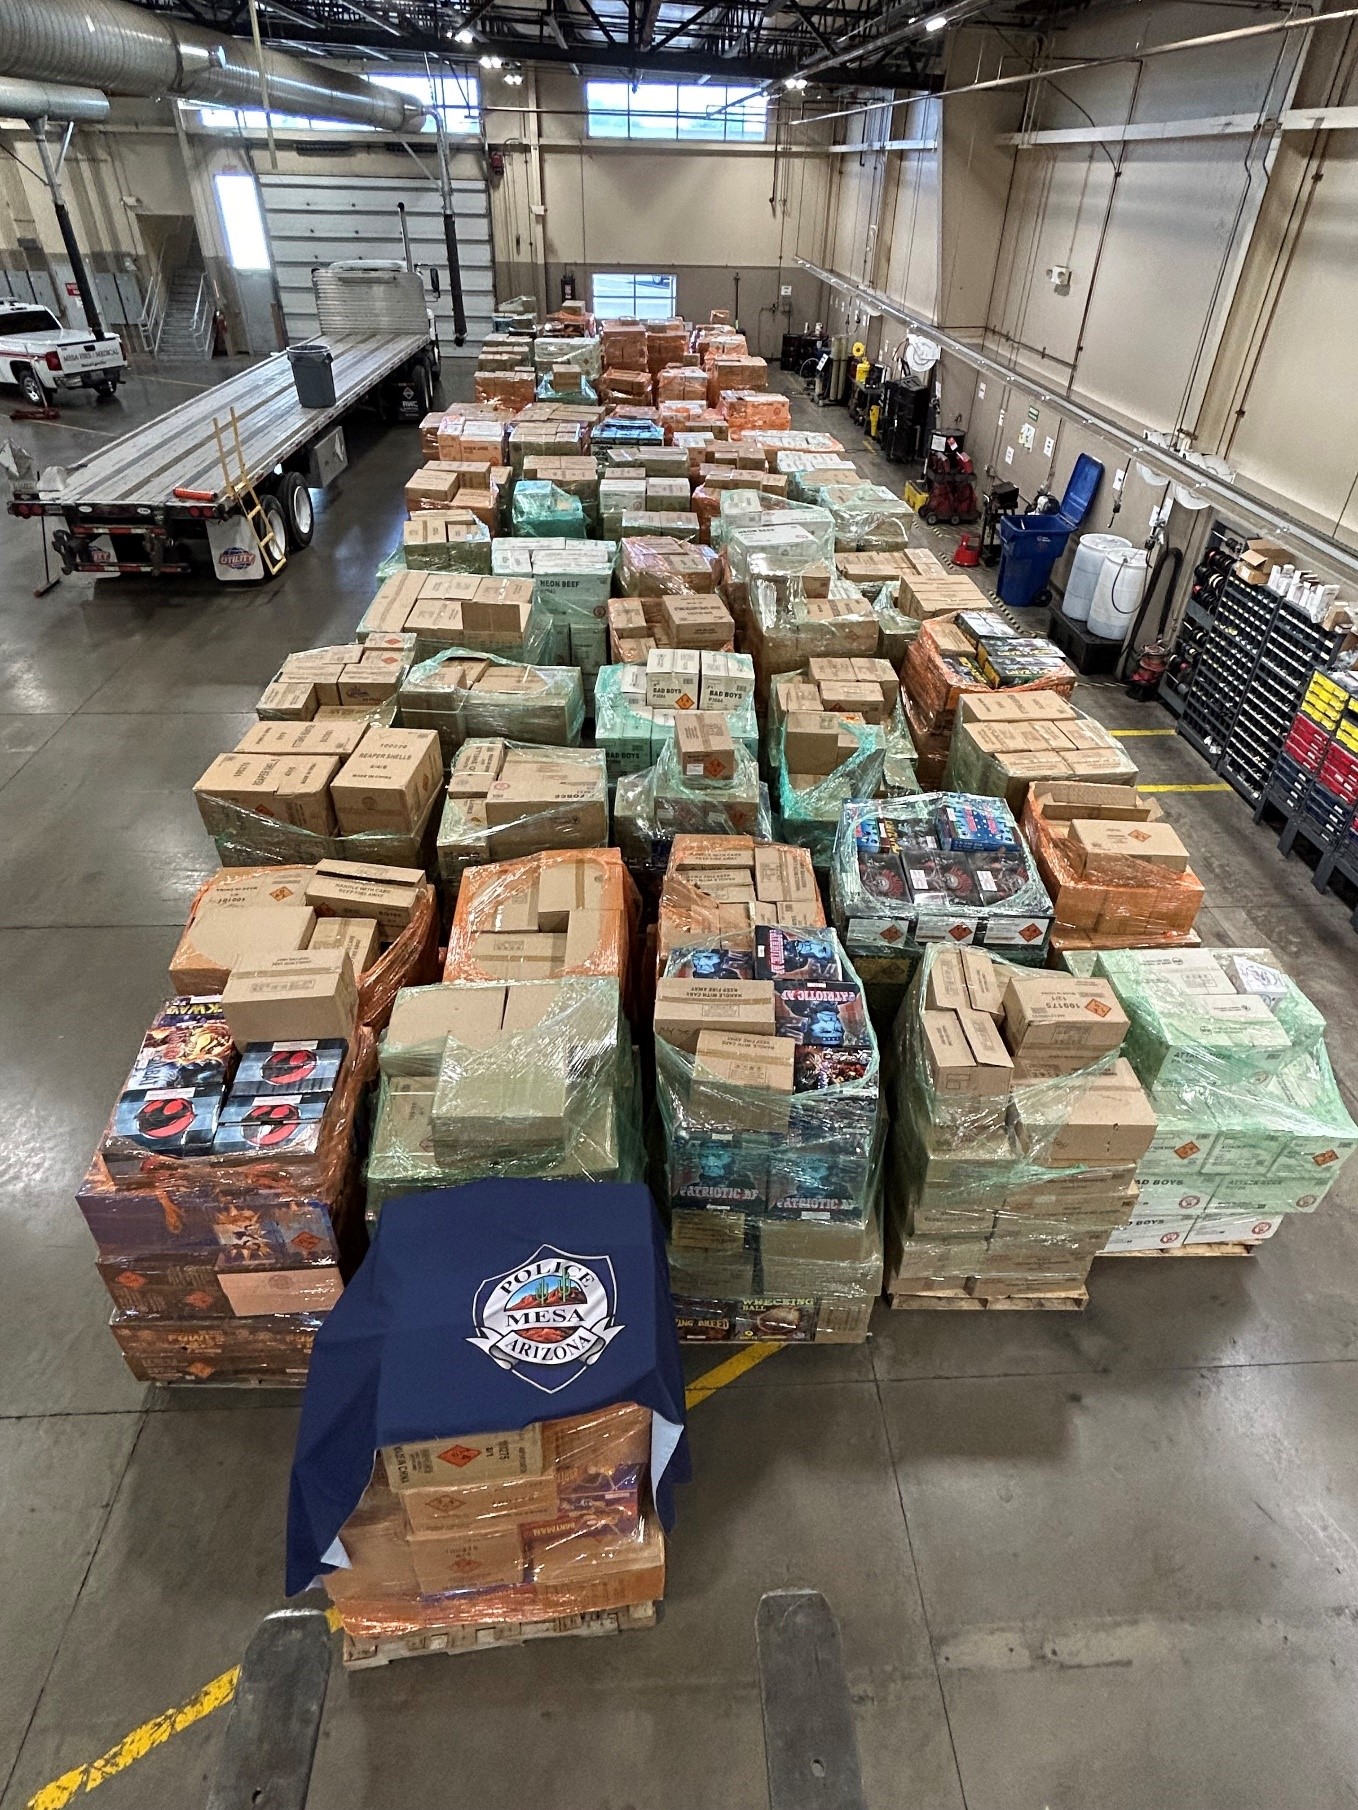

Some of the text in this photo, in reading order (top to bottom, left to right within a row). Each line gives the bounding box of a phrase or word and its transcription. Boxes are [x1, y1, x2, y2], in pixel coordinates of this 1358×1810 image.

[220, 554, 254, 564] UTILITY
[562, 580, 579, 588] BEEF
[782, 989, 856, 1002] PATRIOTIC AF
[680, 1186, 758, 1200] PATRIOTIC AF
[778, 1198, 838, 1209] PATRIOTIC
[500, 1262, 595, 1294] POLICE
[742, 1298, 814, 1307] WRECKING
[742, 1304, 766, 1312] BALL
[506, 1308, 586, 1327] MESA
[506, 1335, 592, 1361] ARIZONA
